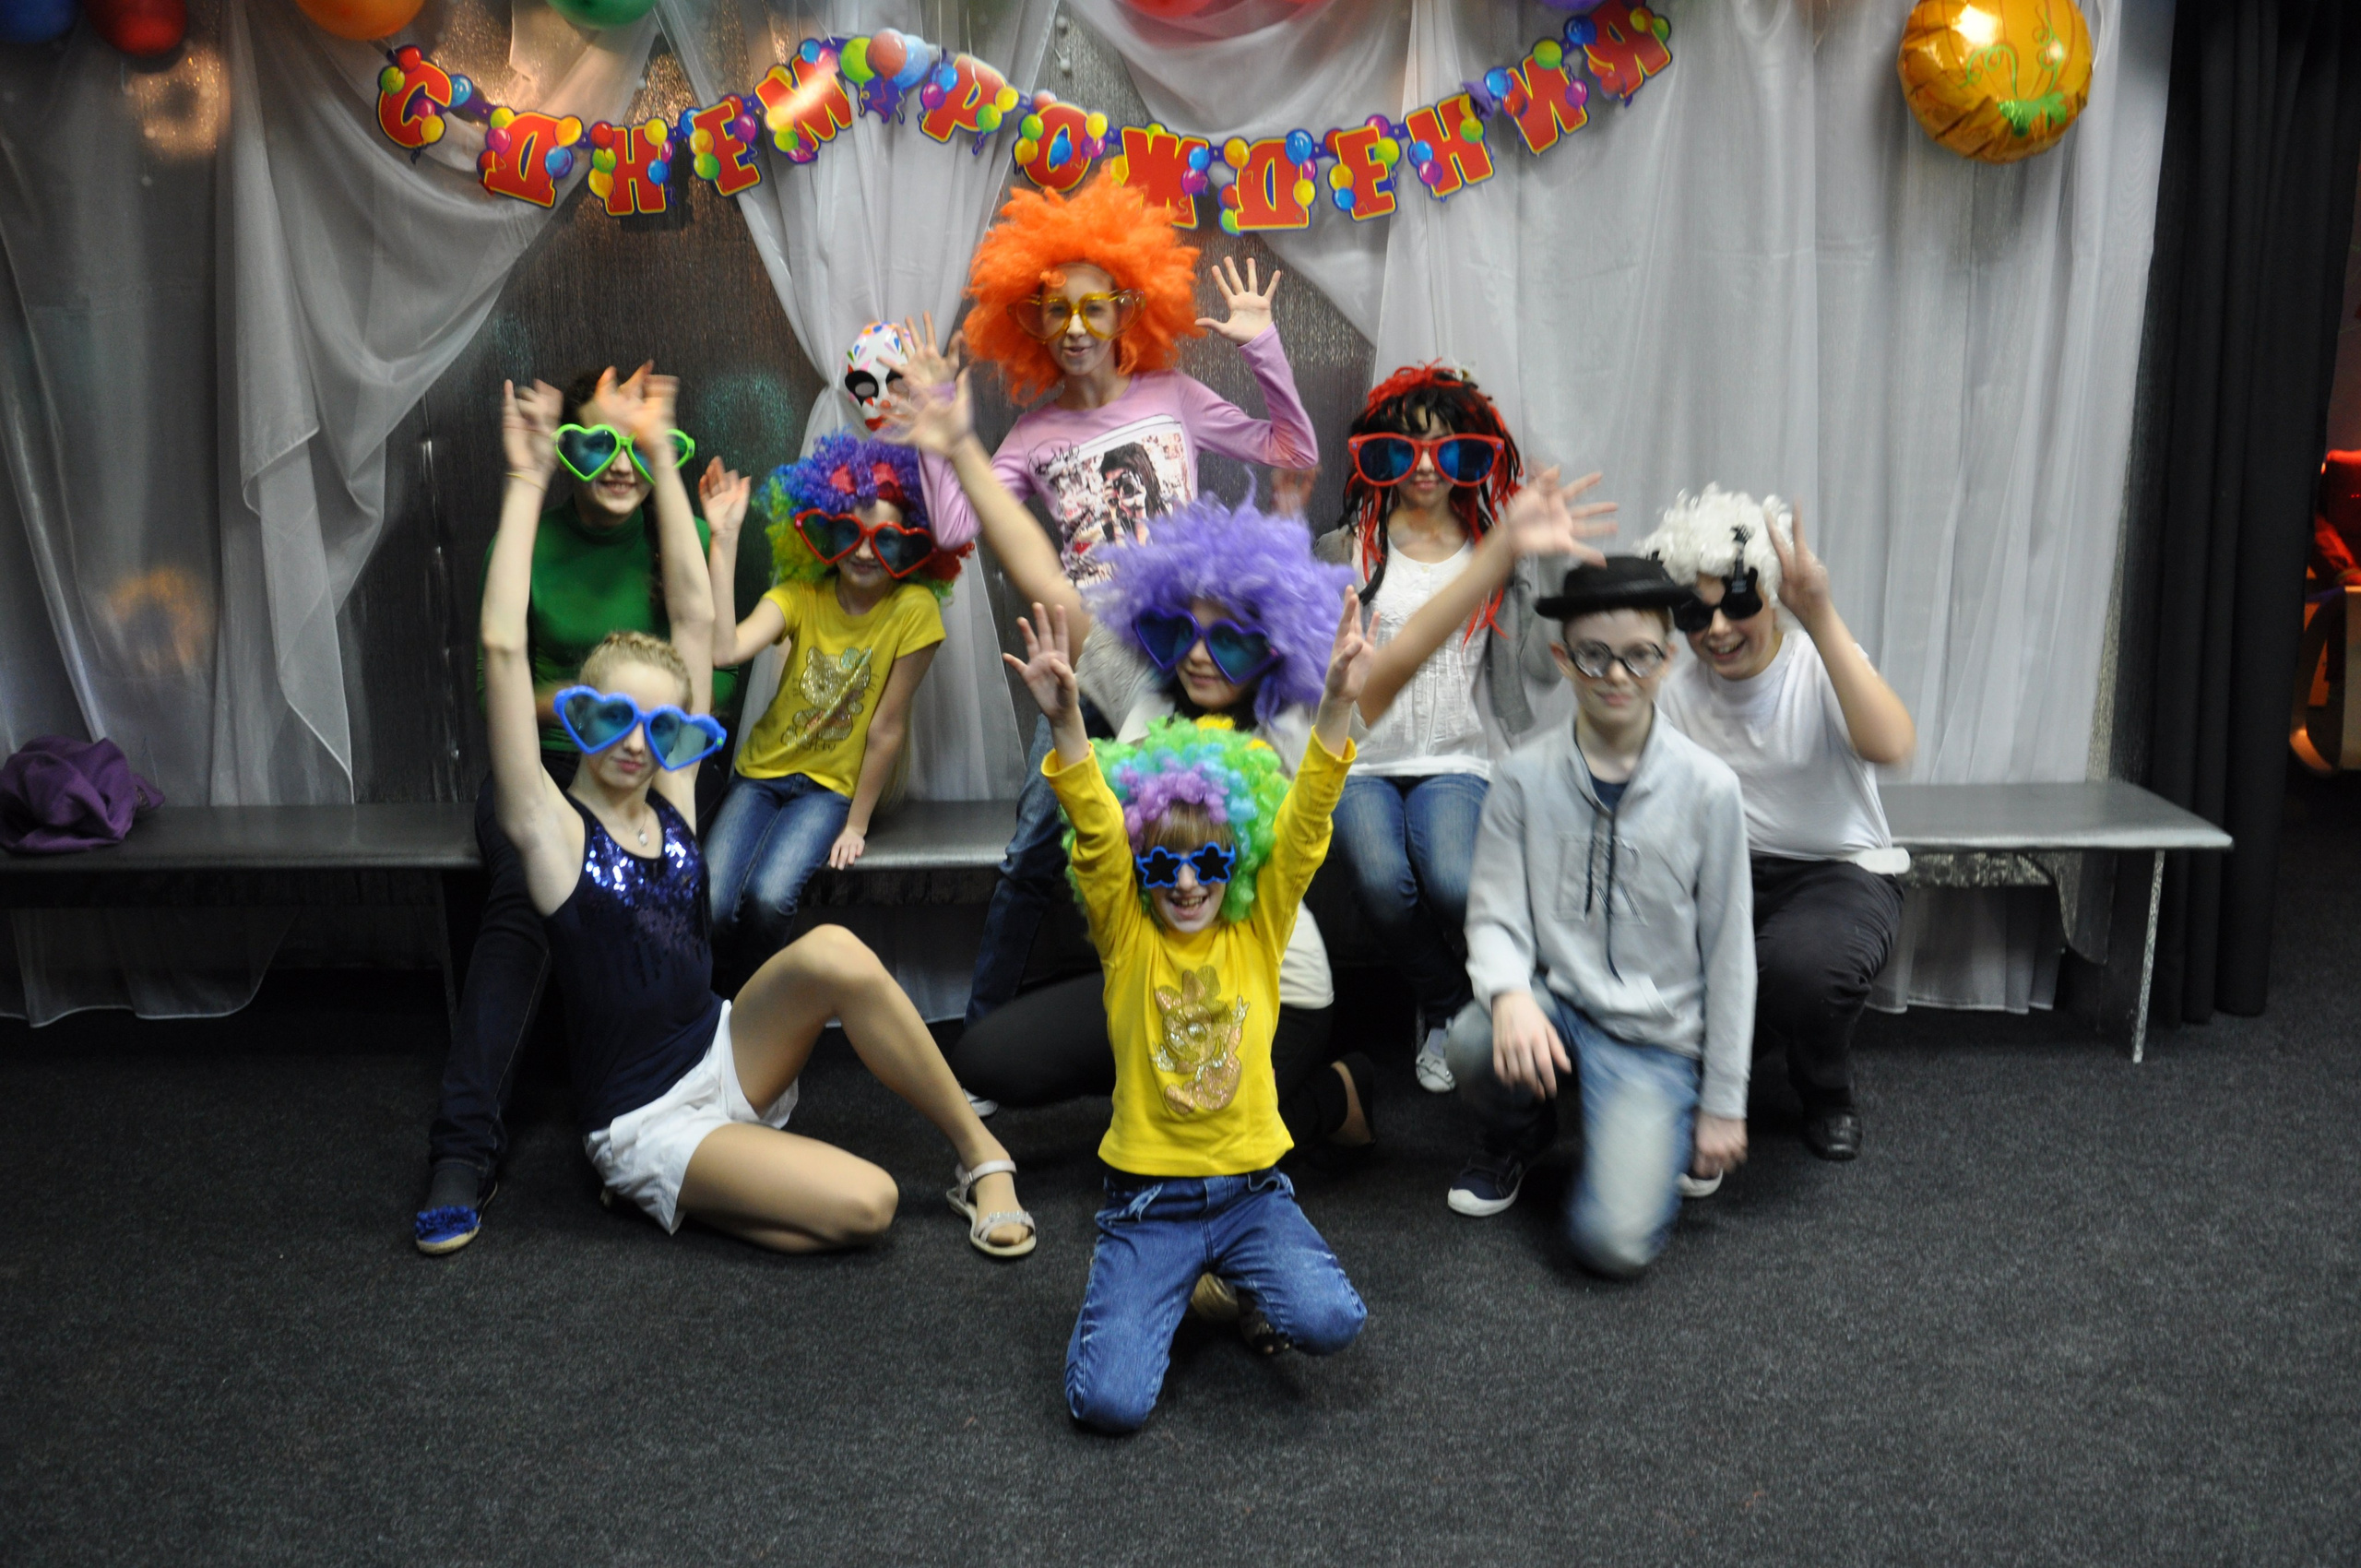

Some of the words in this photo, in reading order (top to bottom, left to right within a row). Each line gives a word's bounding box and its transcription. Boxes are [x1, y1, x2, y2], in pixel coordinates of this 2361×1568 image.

[378, 52, 453, 148] С
[483, 53, 853, 215] ДНЕМ
[920, 0, 1671, 231] РОЖДЕНИЯ
